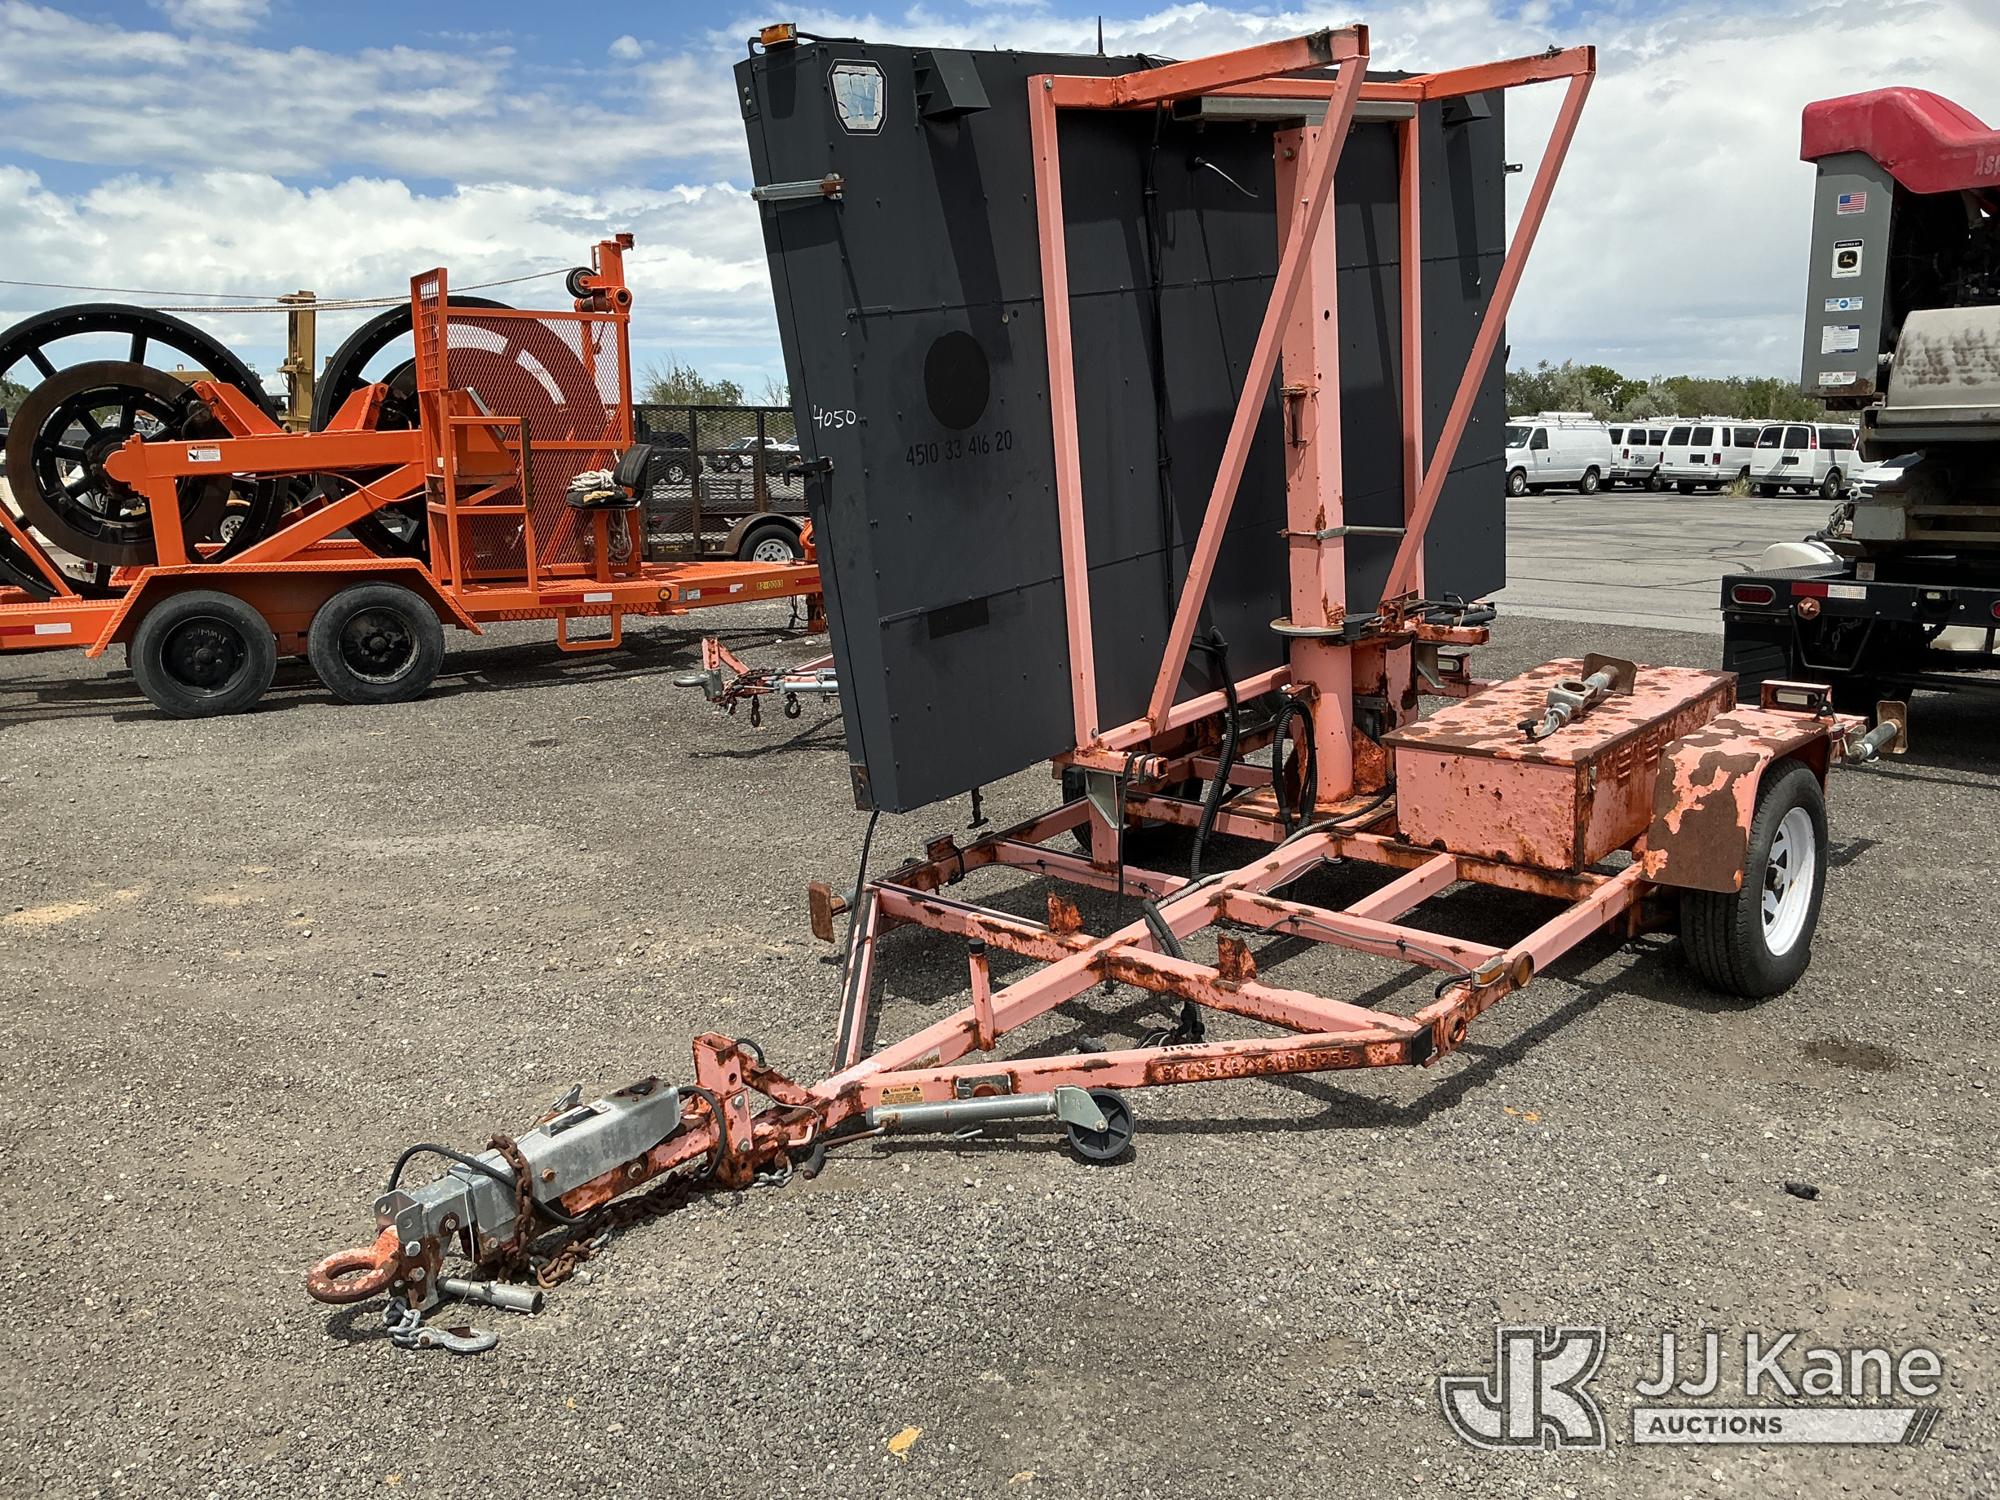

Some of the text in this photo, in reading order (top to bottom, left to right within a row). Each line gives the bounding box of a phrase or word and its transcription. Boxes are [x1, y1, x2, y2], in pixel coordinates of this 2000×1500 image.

[813, 404, 857, 430] 4050
[906, 430, 1013, 467] 4510 33 416 20
